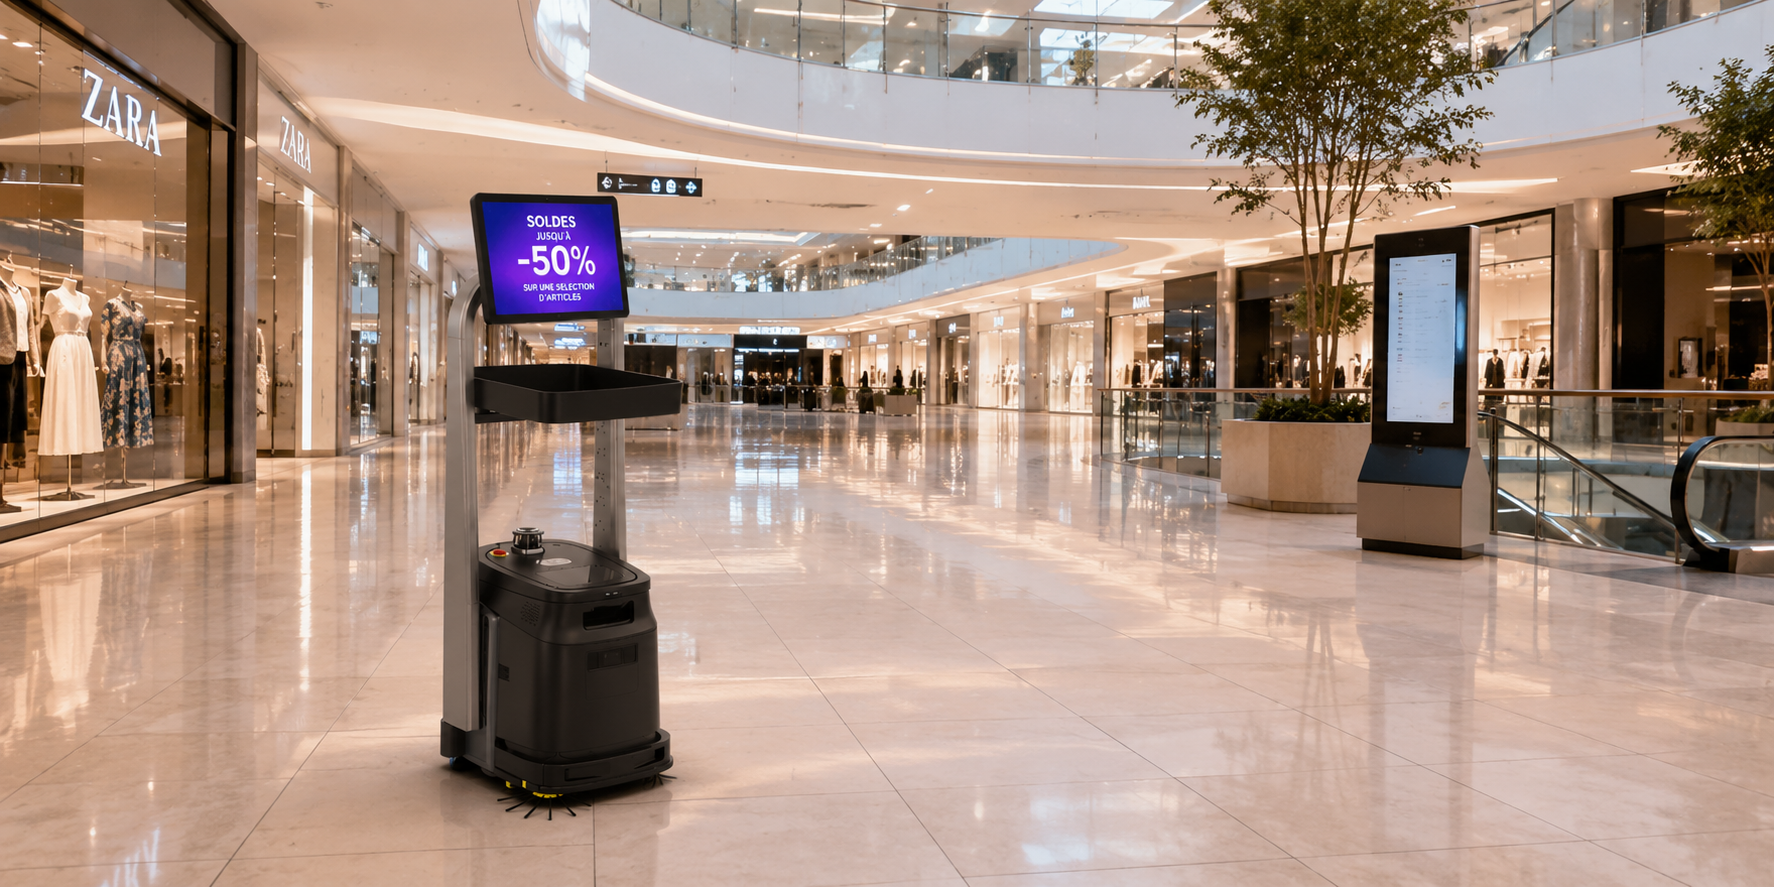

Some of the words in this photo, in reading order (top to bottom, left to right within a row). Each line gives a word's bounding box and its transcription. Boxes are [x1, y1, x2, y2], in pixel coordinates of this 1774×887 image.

[81, 67, 162, 157] ZARA
[280, 115, 312, 174] ZARA
[526, 215, 577, 228] SOLDES
[517, 244, 596, 276] -50%
[523, 283, 538, 292] SUR
[539, 283, 555, 291] UNE
[538, 292, 582, 302] D'ARTICLES
